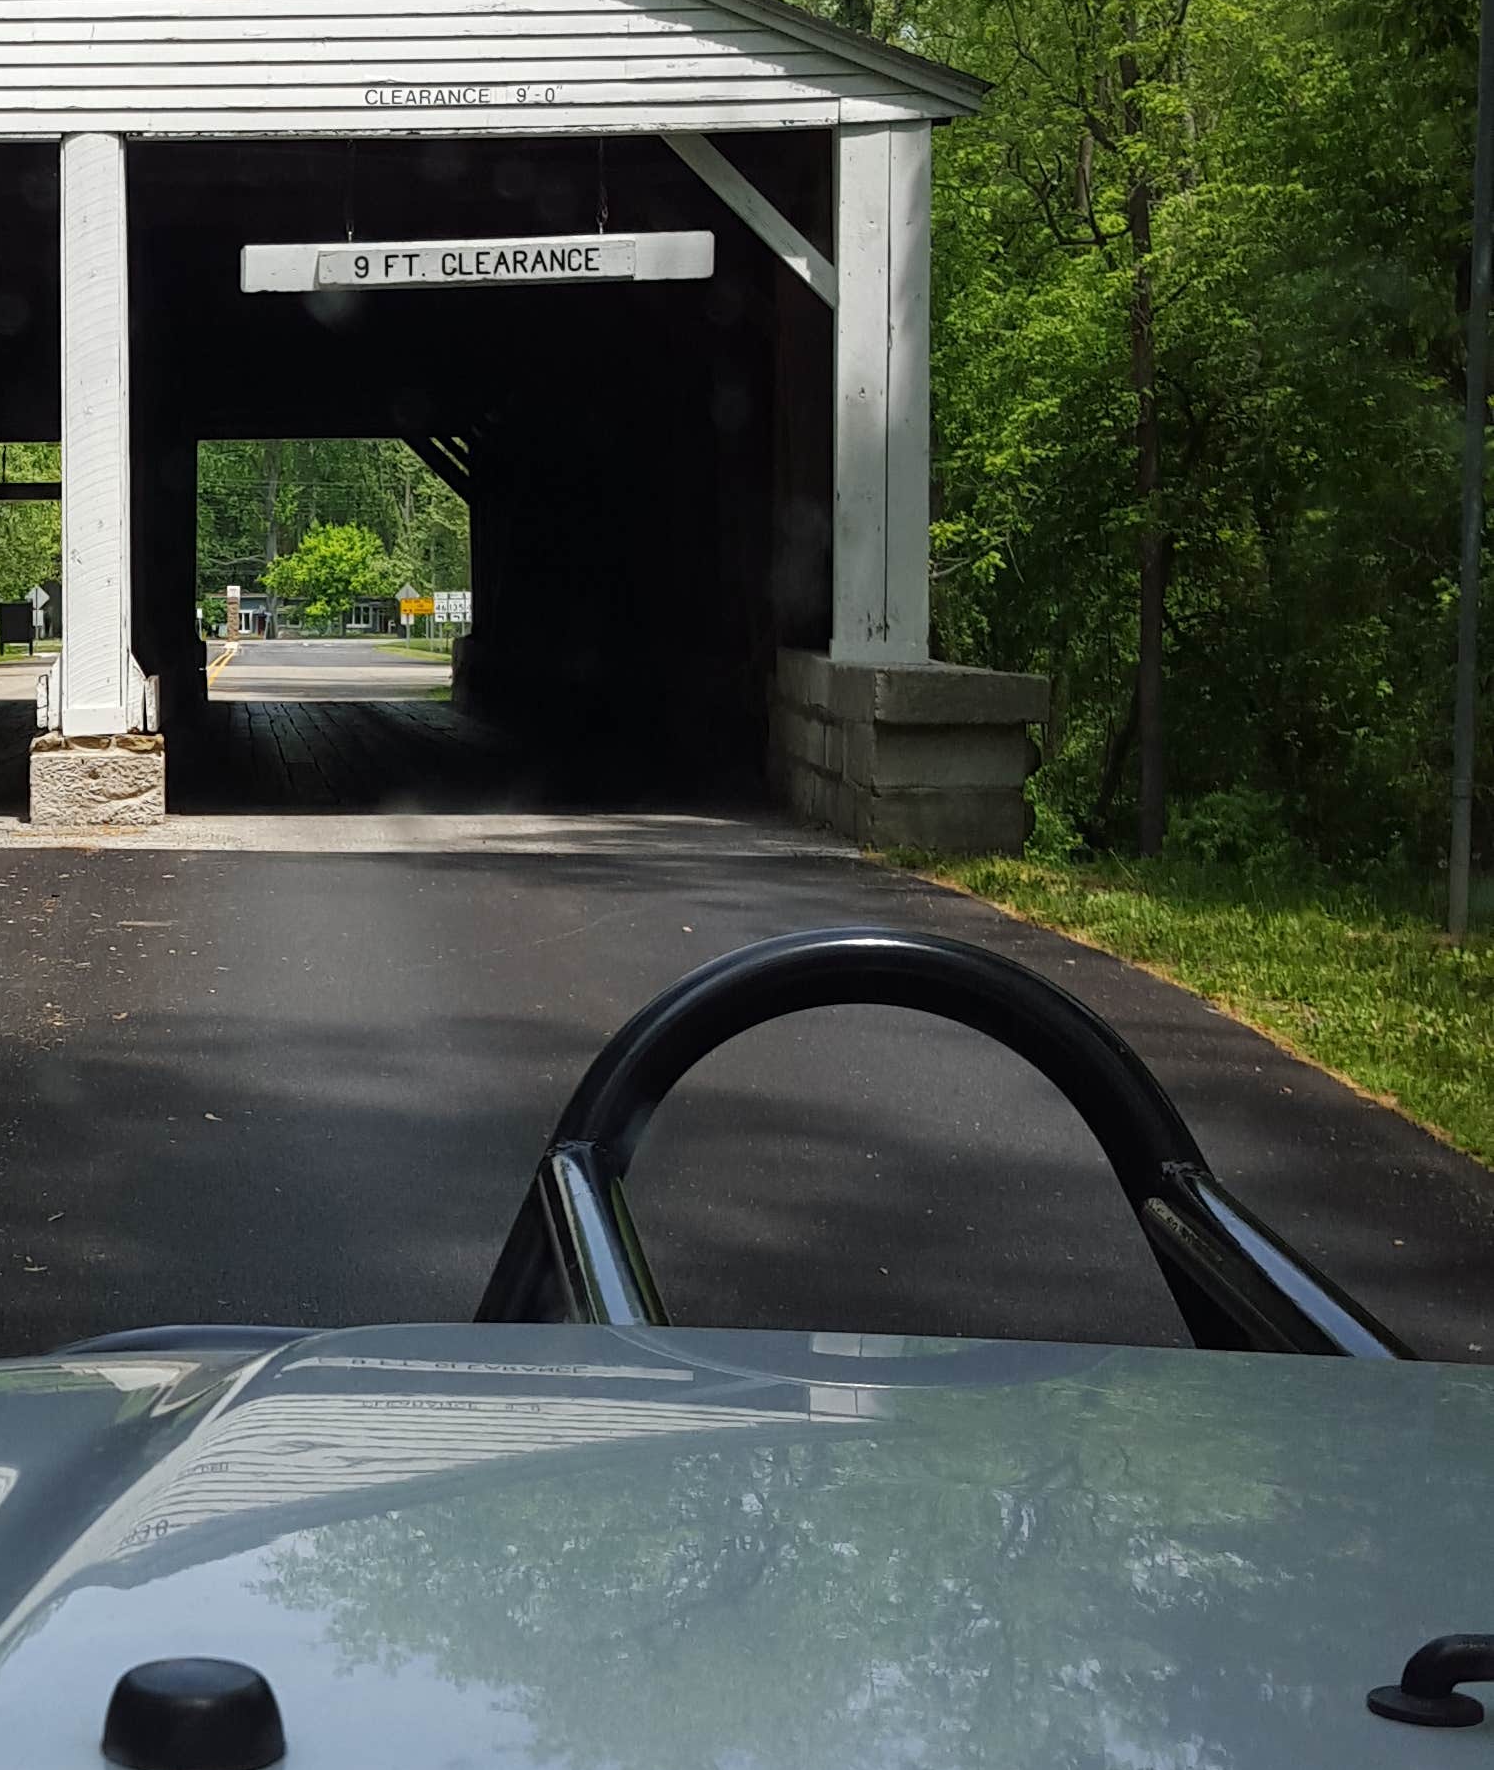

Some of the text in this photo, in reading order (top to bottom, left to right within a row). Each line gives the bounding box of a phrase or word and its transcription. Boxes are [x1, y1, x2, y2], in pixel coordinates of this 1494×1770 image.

[365, 88, 491, 105] CLEARANCE
[354, 247, 601, 278] 9 FT. CLEARANCE
